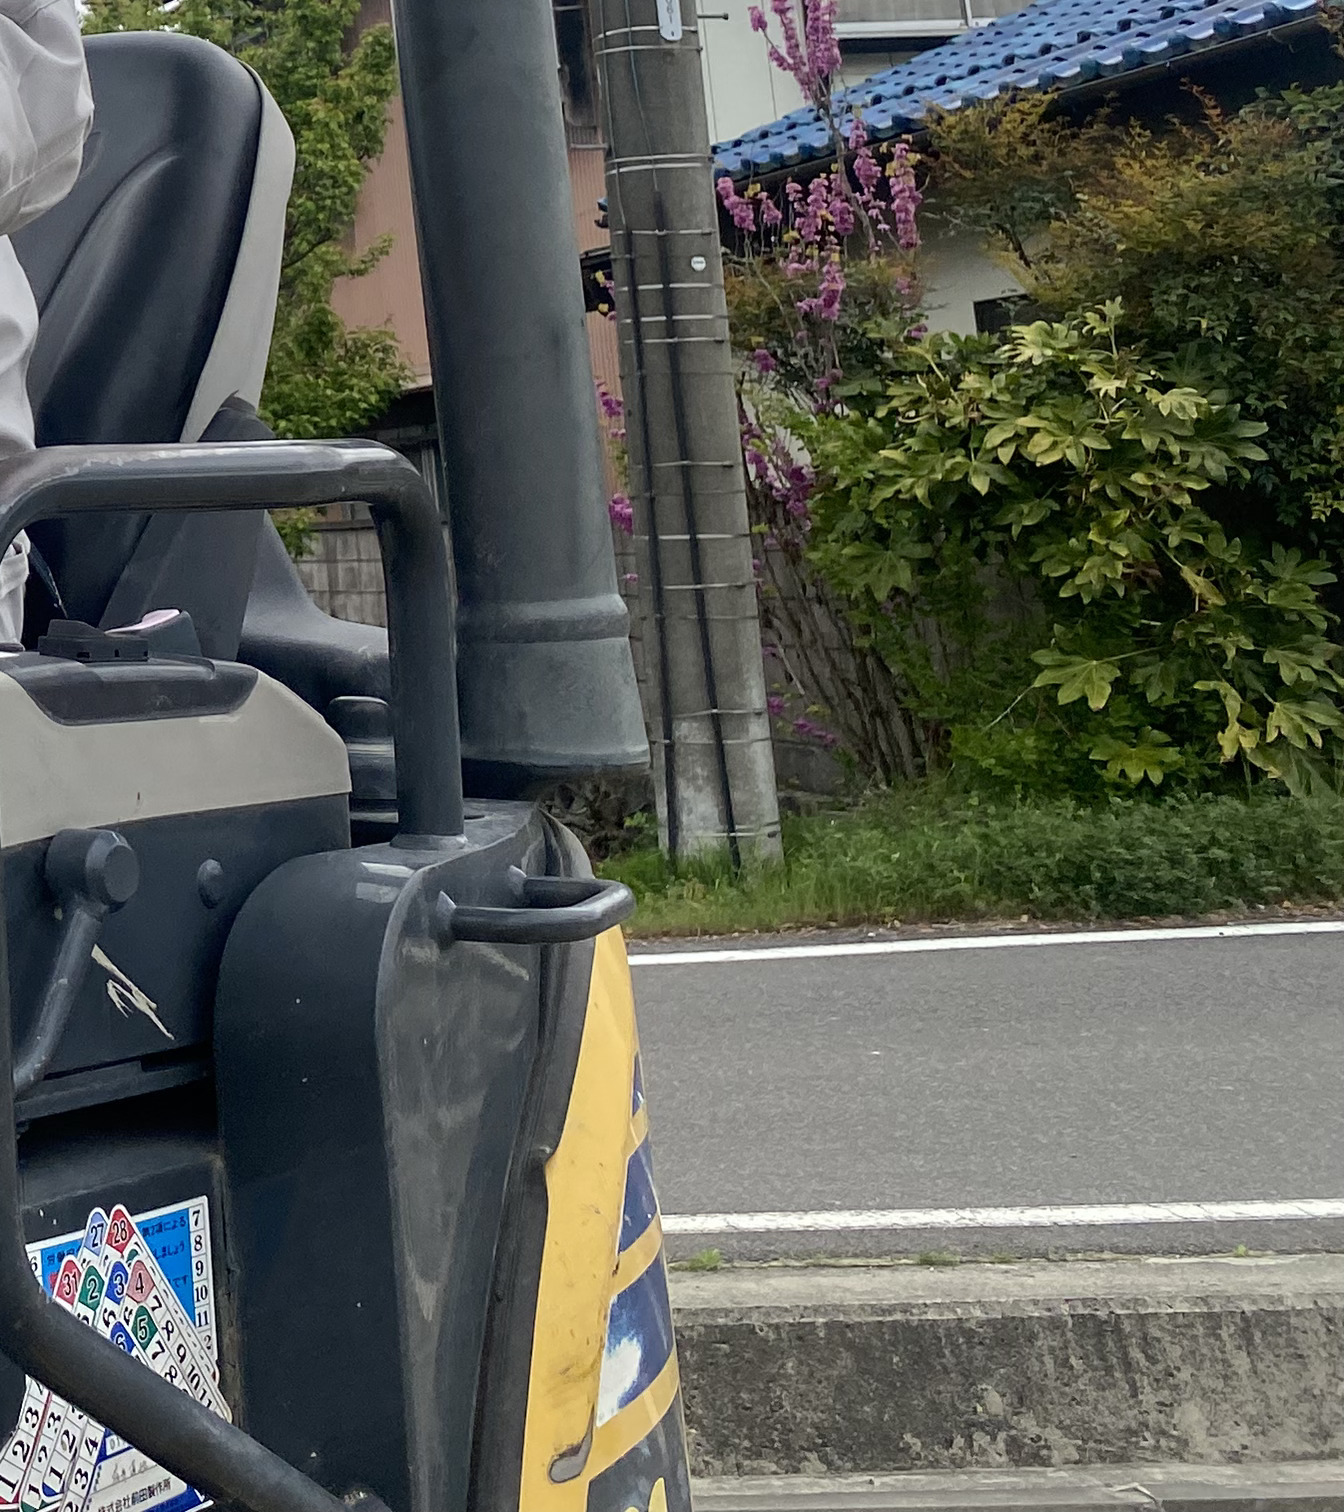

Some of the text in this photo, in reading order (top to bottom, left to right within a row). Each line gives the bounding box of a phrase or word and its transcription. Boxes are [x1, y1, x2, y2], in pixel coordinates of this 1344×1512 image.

[192, 1210, 201, 1226] 7
[90, 1223, 105, 1248] 27
[113, 1219, 127, 1244] 28
[193, 1234, 203, 1252] 8
[195, 1260, 204, 1276] 9
[62, 1268, 78, 1297] 31
[86, 1277, 99, 1302] 2
[114, 1271, 125, 1296] 3
[135, 1271, 145, 1295] 4
[195, 1284, 208, 1302] 10
[137, 1315, 149, 1341] 5
[197, 1310, 210, 1328] 11
[25, 1406, 40, 1430] 3
[13, 1440, 31, 1464] 2
[62, 1429, 76, 1451] 2
[85, 1436, 100, 1458] 4
[74, 1467, 90, 1490] 3
